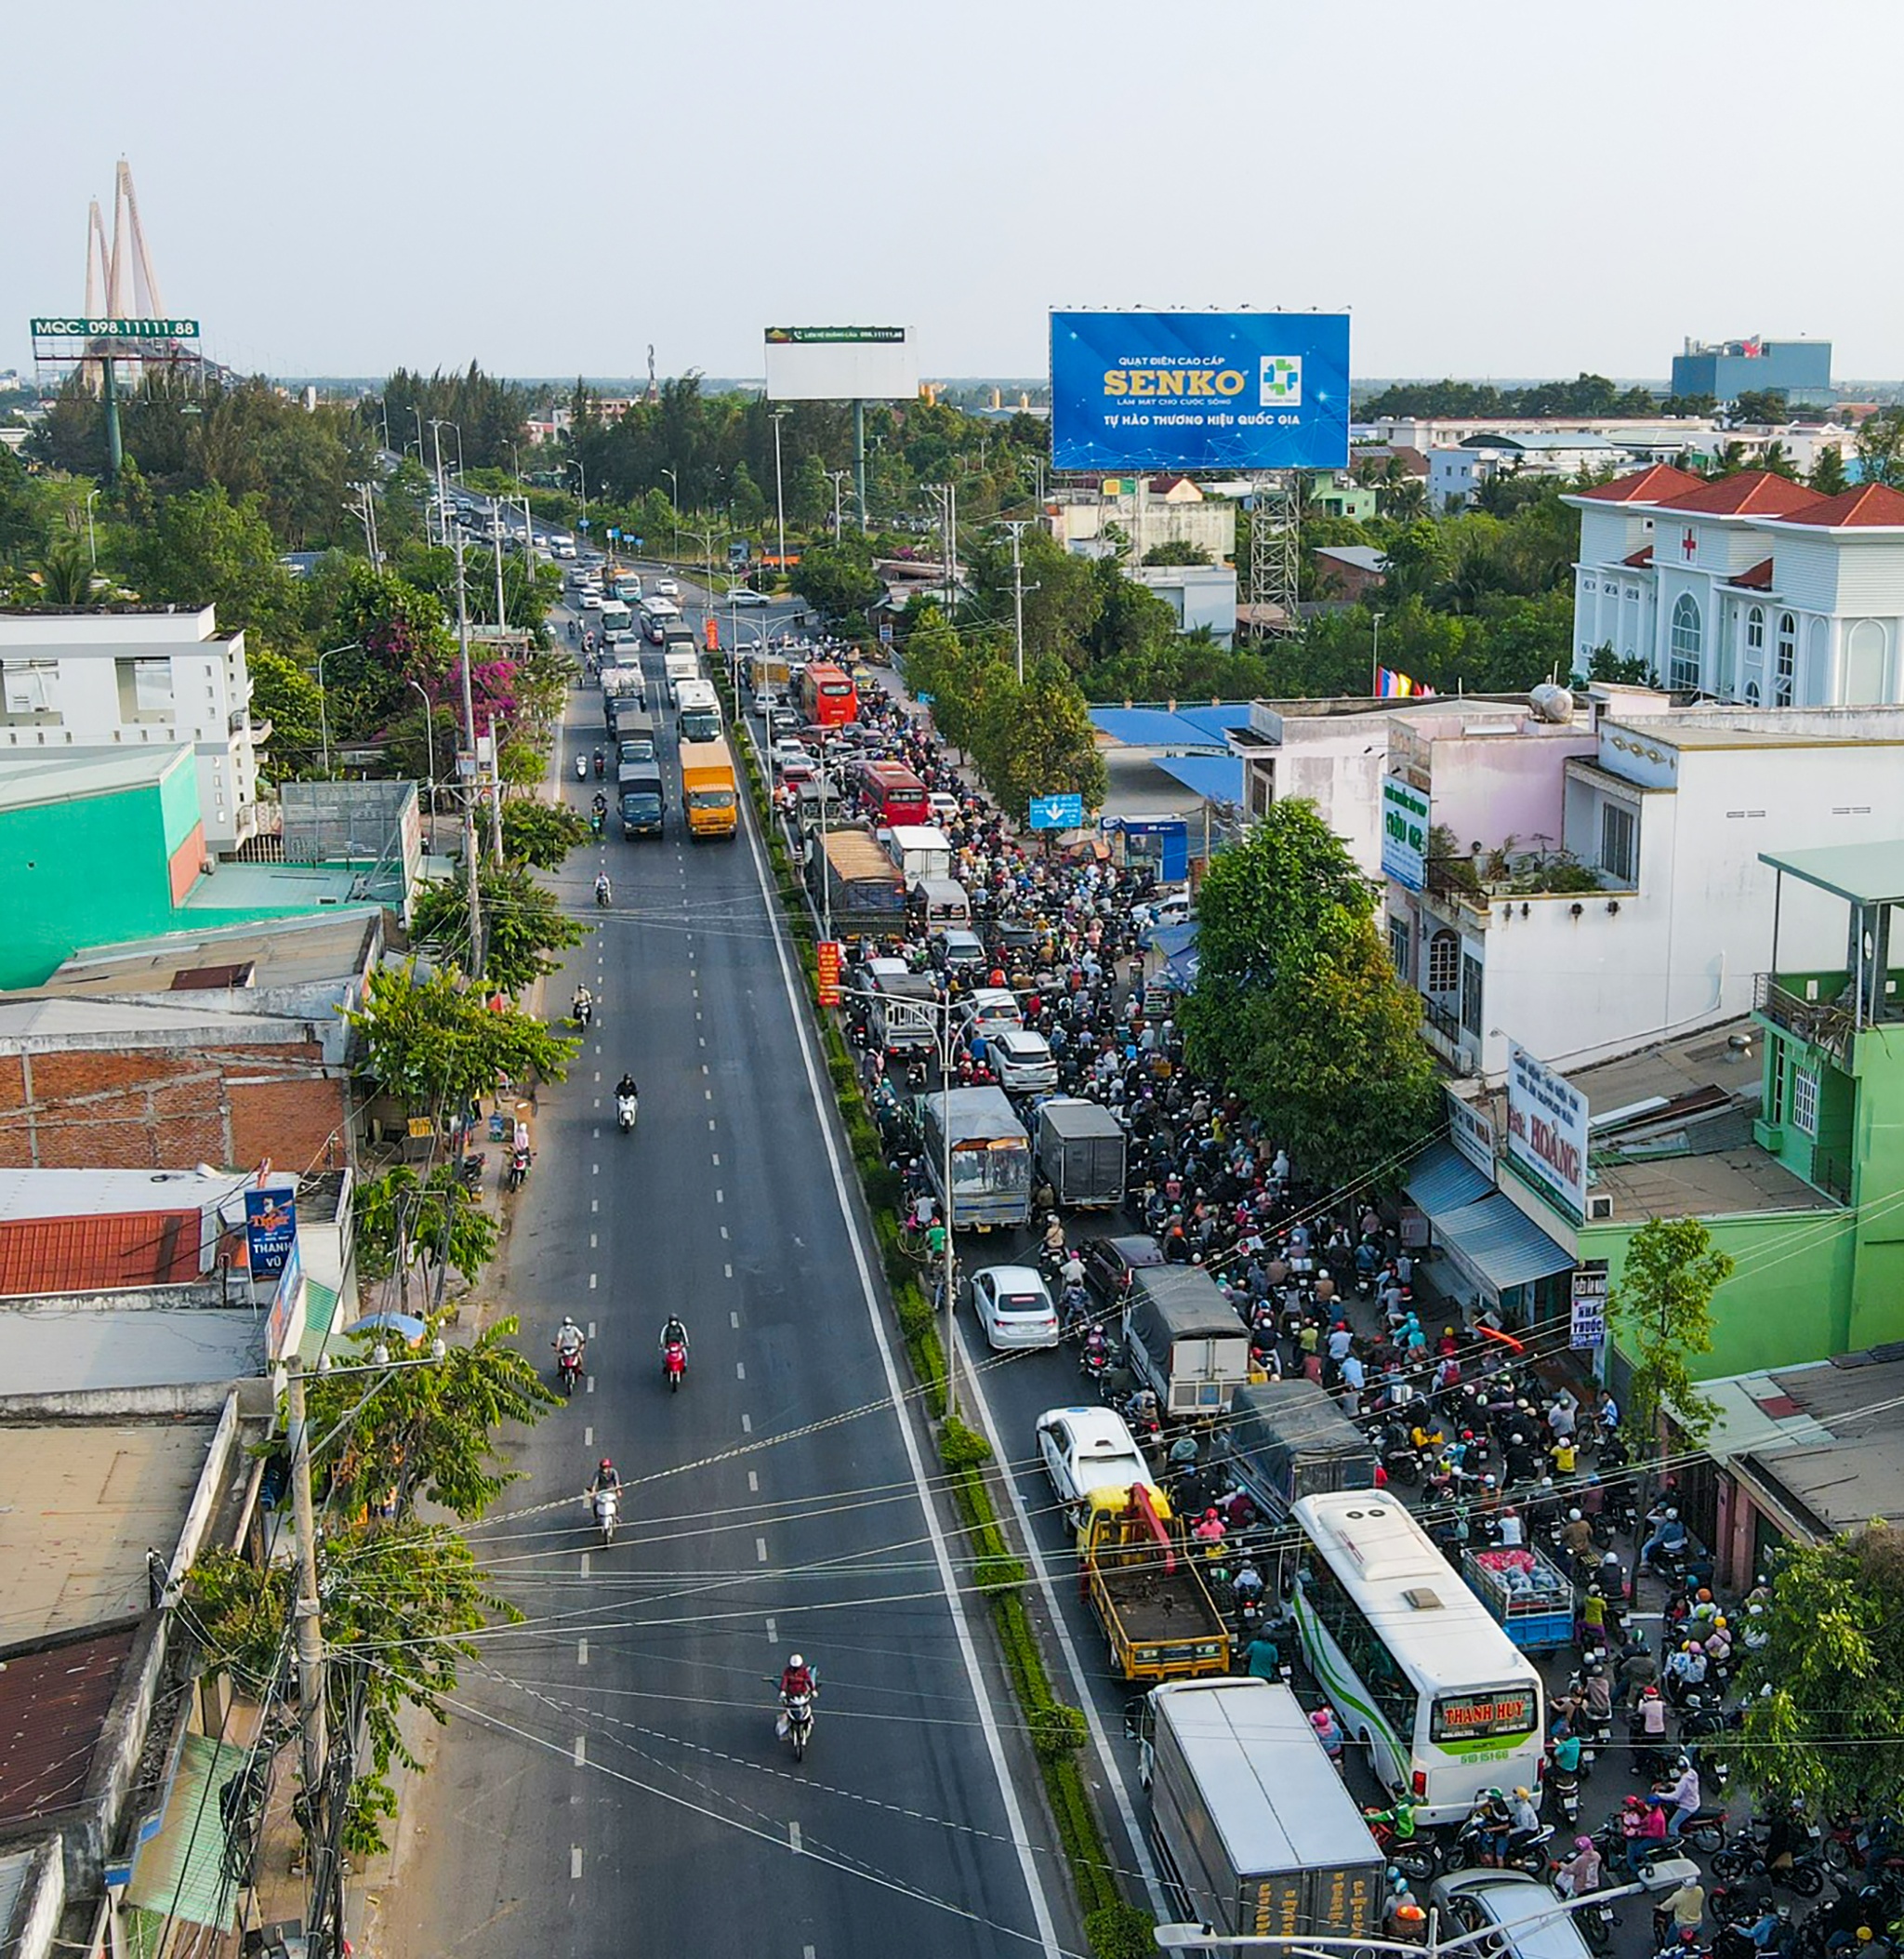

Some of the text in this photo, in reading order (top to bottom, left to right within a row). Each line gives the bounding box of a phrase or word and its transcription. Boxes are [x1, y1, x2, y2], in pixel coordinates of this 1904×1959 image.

[36, 322, 194, 335] MQC: 098.11111.88
[1178, 357, 1201, 365] CAO
[1104, 369, 1245, 396] SENKO
[1104, 411, 1301, 429] TỰ HÀO THƯƠNG HIỆU QUỐC GIA
[1444, 1700, 1525, 1726] THANH HUY
